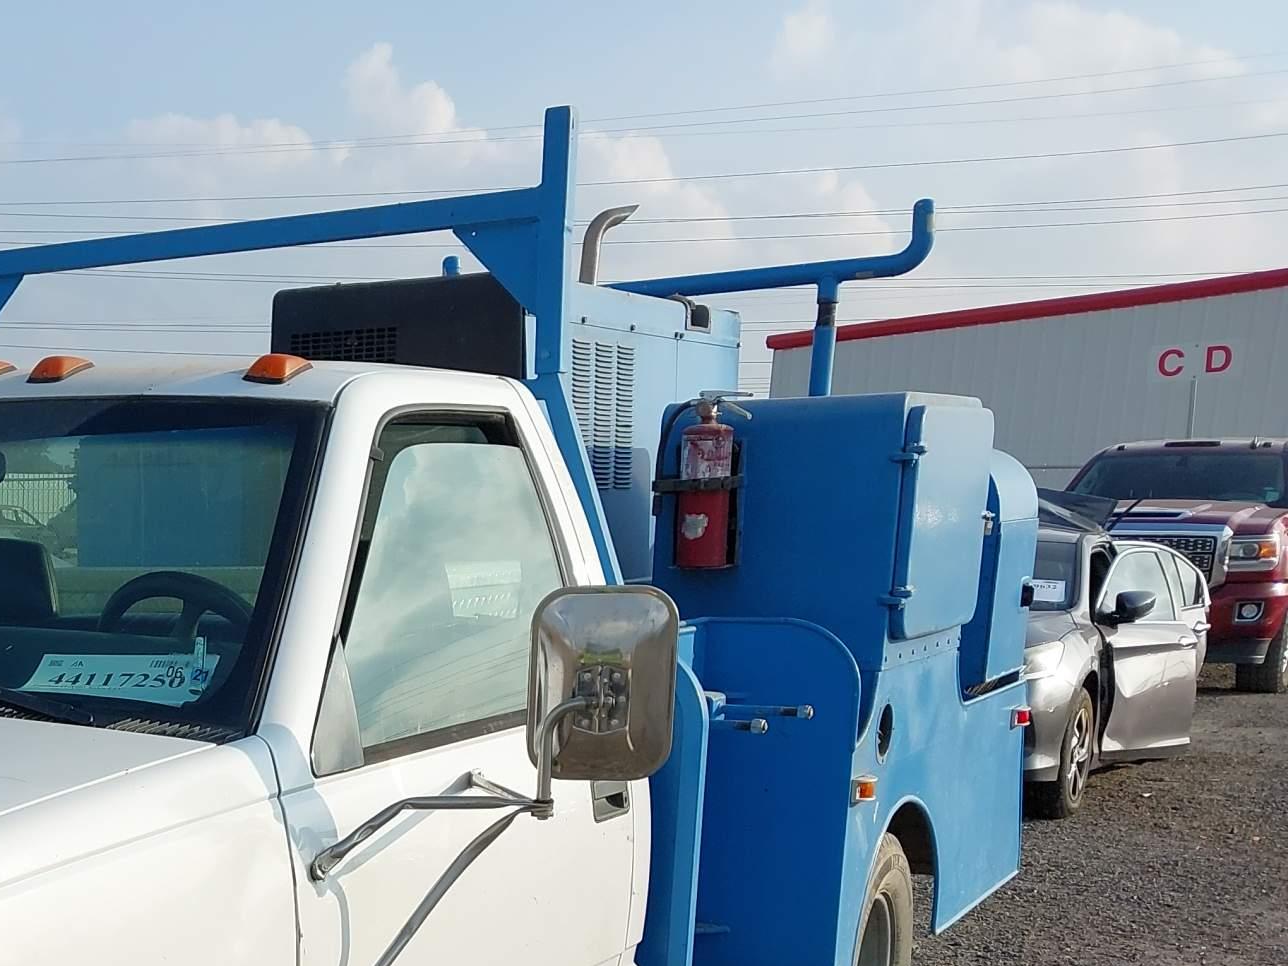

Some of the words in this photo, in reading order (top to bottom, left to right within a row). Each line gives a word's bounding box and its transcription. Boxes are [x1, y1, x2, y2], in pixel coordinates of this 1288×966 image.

[1158, 348, 1185, 377] C
[1205, 345, 1233, 373] D
[48, 672, 186, 689] 44117250
[166, 665, 184, 679] 06
